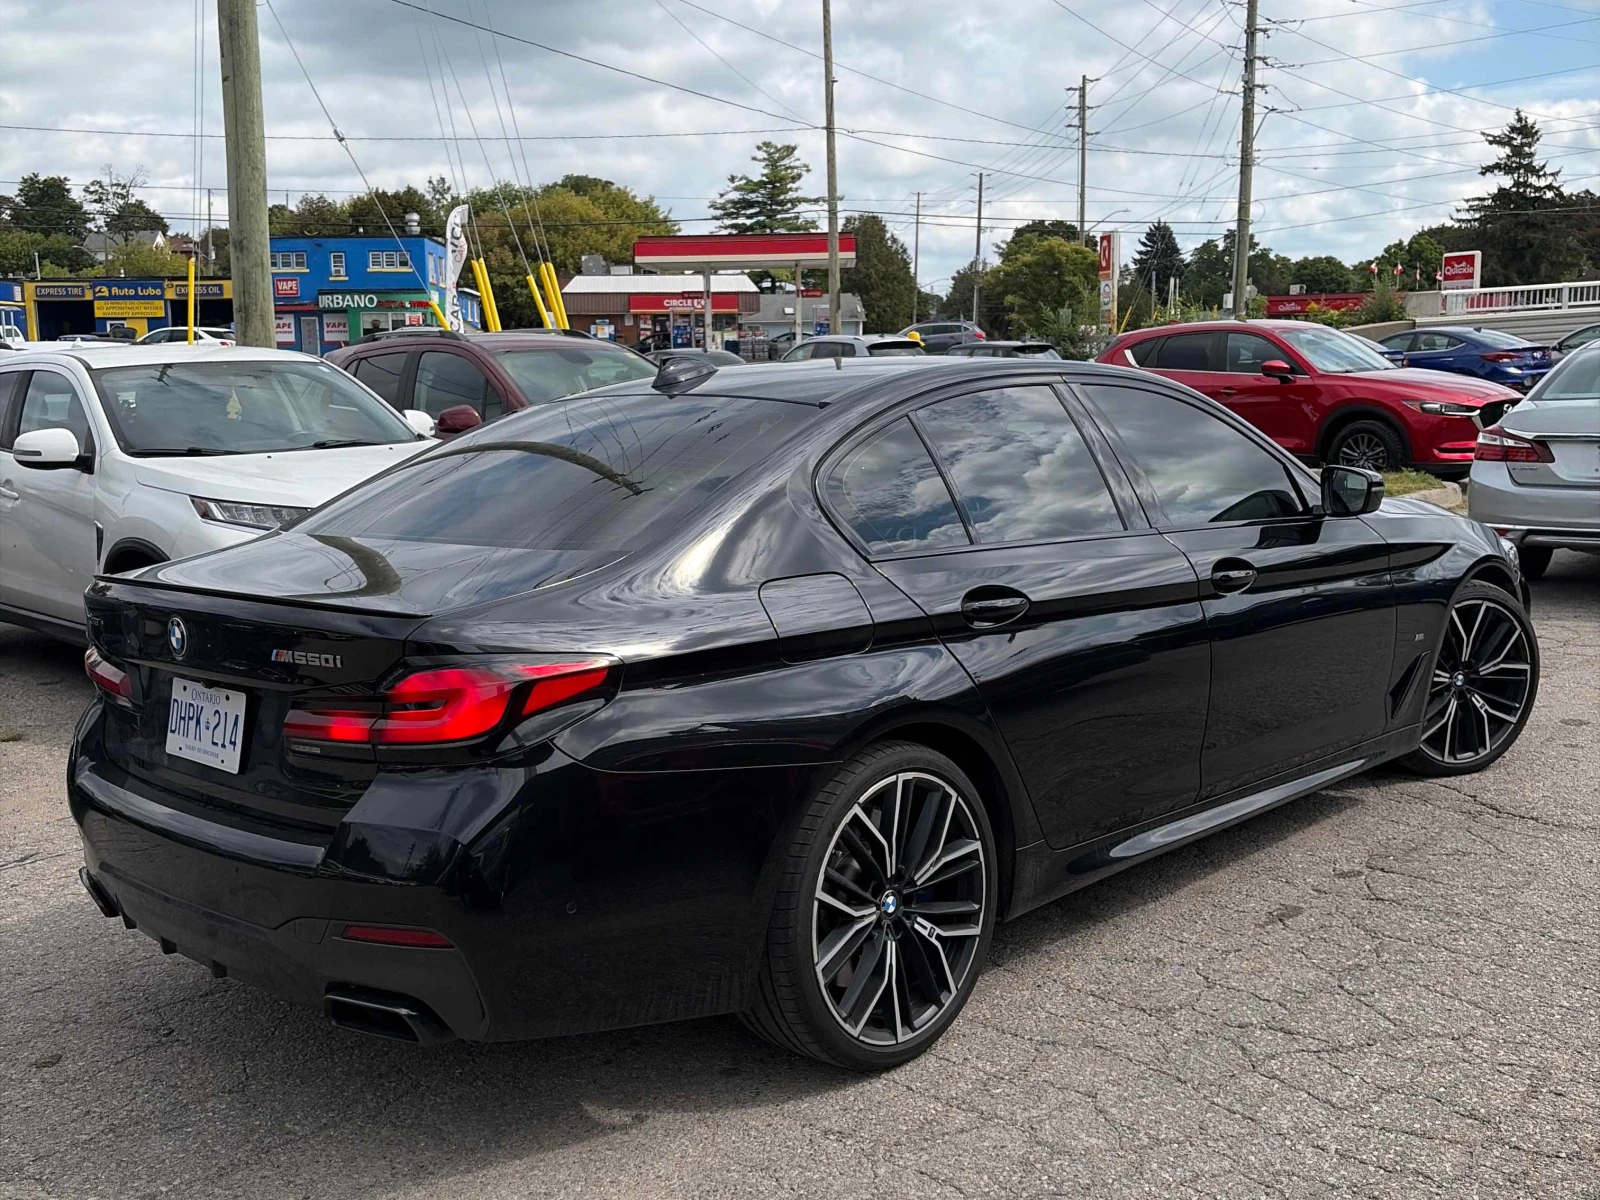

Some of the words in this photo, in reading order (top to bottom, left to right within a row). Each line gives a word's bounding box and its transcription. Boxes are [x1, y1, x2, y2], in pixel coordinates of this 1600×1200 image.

[1445, 265, 1474, 275] Quickie
[176, 286, 207, 294] EXPESS
[208, 286, 220, 294] OIL
[277, 281, 297, 290] VAPE
[37, 287, 66, 295] EXPRESS
[68, 287, 83, 295] TIRE
[112, 287, 135, 295] Auto
[137, 287, 162, 295] Lube
[318, 294, 377, 308] URBANO
[663, 299, 693, 307] CIRCLE
[693, 299, 705, 309] K
[271, 649, 342, 668] M550i
[191, 688, 220, 705] ONTARIO
[169, 698, 204, 742] DHPK
[211, 709, 239, 752] 214
